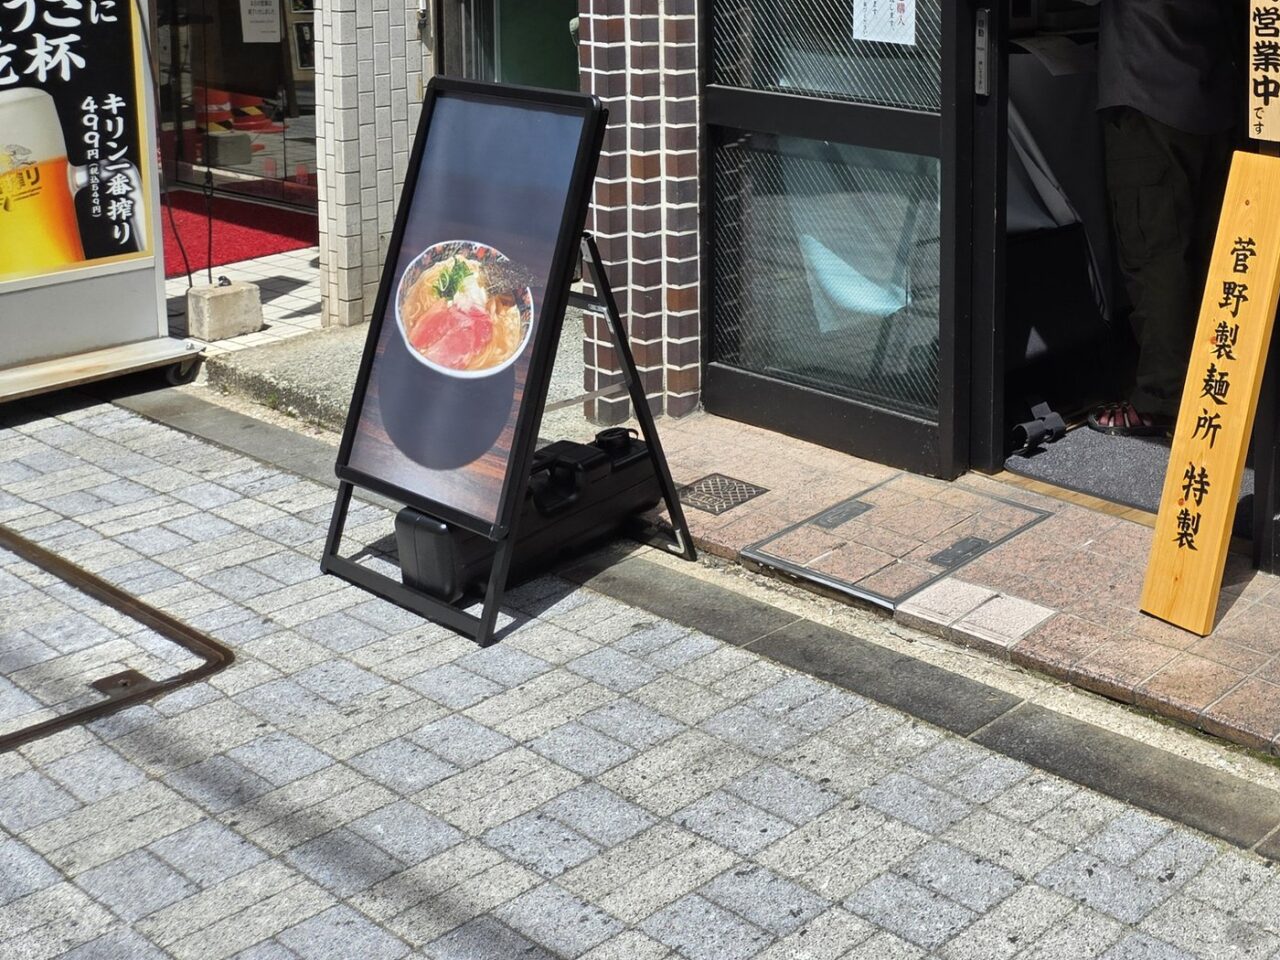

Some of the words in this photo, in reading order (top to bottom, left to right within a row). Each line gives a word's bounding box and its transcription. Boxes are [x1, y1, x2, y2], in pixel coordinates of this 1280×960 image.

[81, 95, 100, 160] 499円
[101, 93, 134, 245] キリン一番搾り
[1191, 237, 1257, 450] 菅野製麺所
[1172, 464, 1211, 552] 特製
